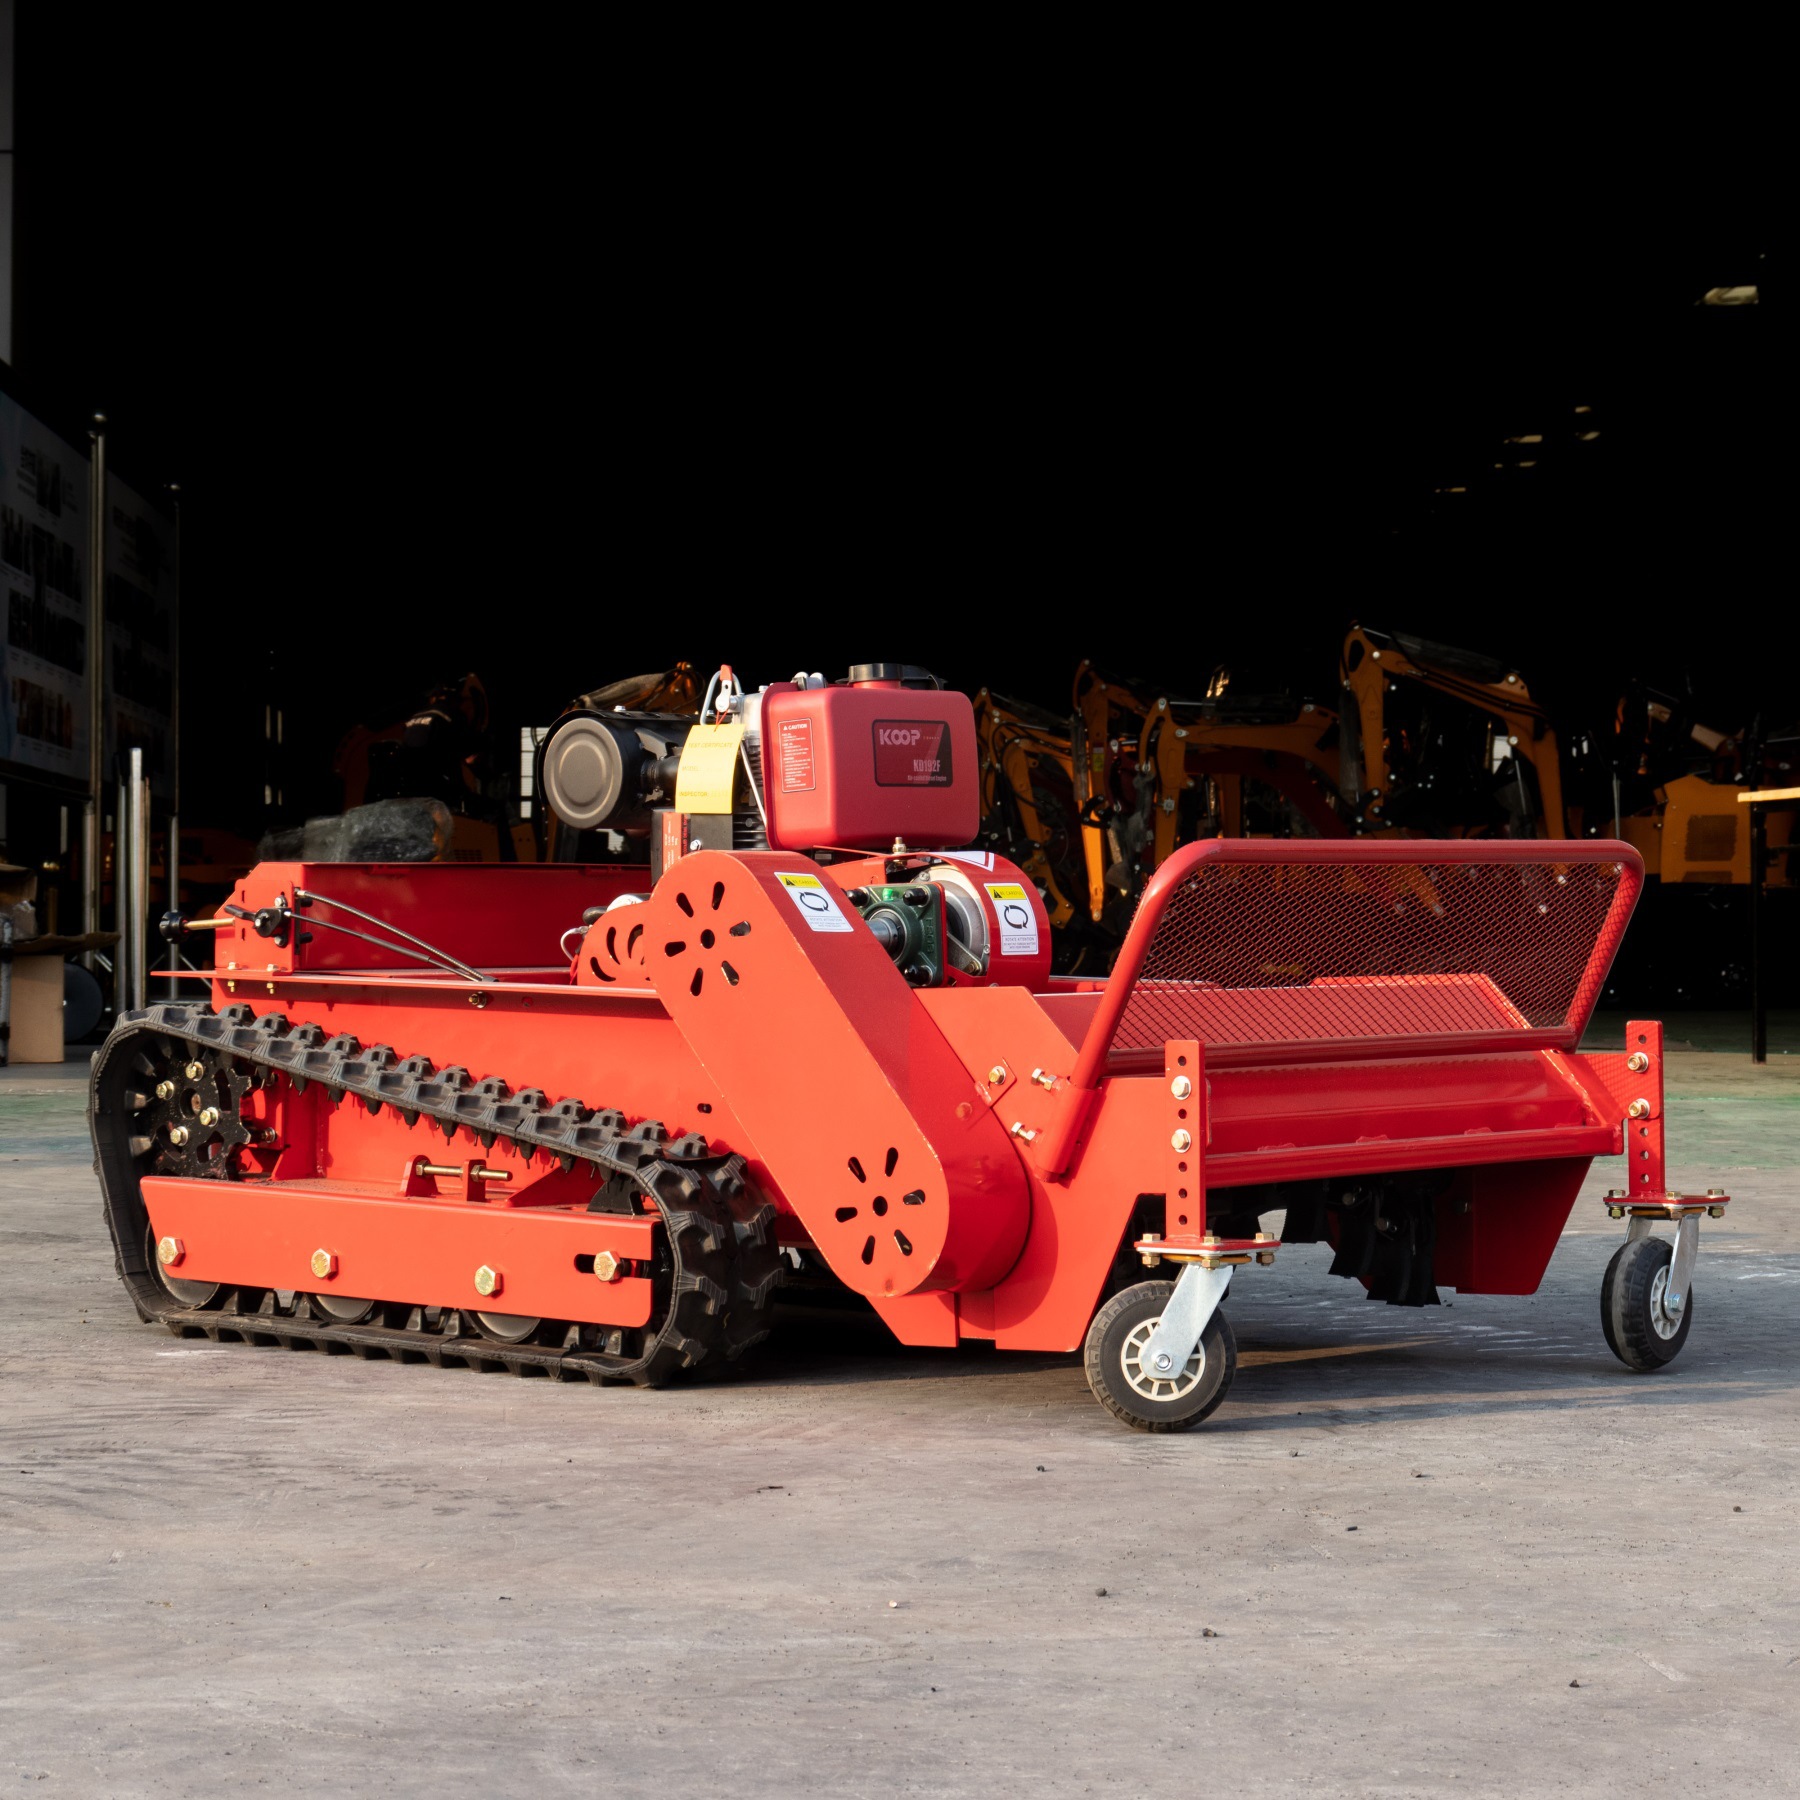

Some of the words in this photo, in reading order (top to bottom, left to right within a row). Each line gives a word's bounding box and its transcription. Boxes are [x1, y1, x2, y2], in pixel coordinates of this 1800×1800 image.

[787, 723, 808, 731] CAUTION
[879, 728, 921, 746] KOOP
[913, 759, 941, 772] KD192F
